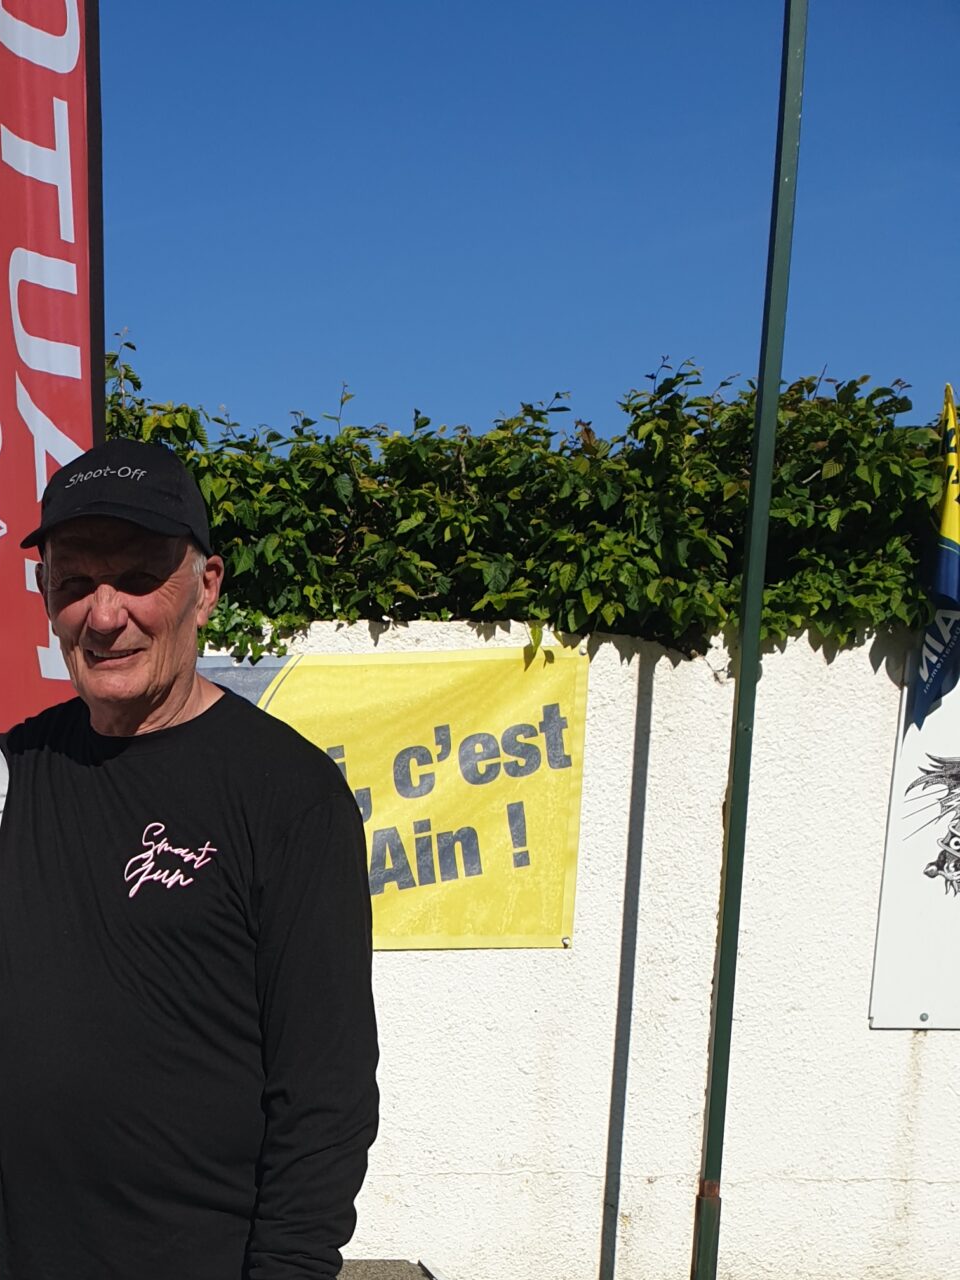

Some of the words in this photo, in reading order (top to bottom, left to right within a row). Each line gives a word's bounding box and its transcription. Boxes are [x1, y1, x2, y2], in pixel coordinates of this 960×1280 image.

[65, 466, 148, 488] Shoot-Off
[393, 703, 572, 799] c'est
[142, 822, 217, 869] Smart
[124, 851, 193, 898] Gun
